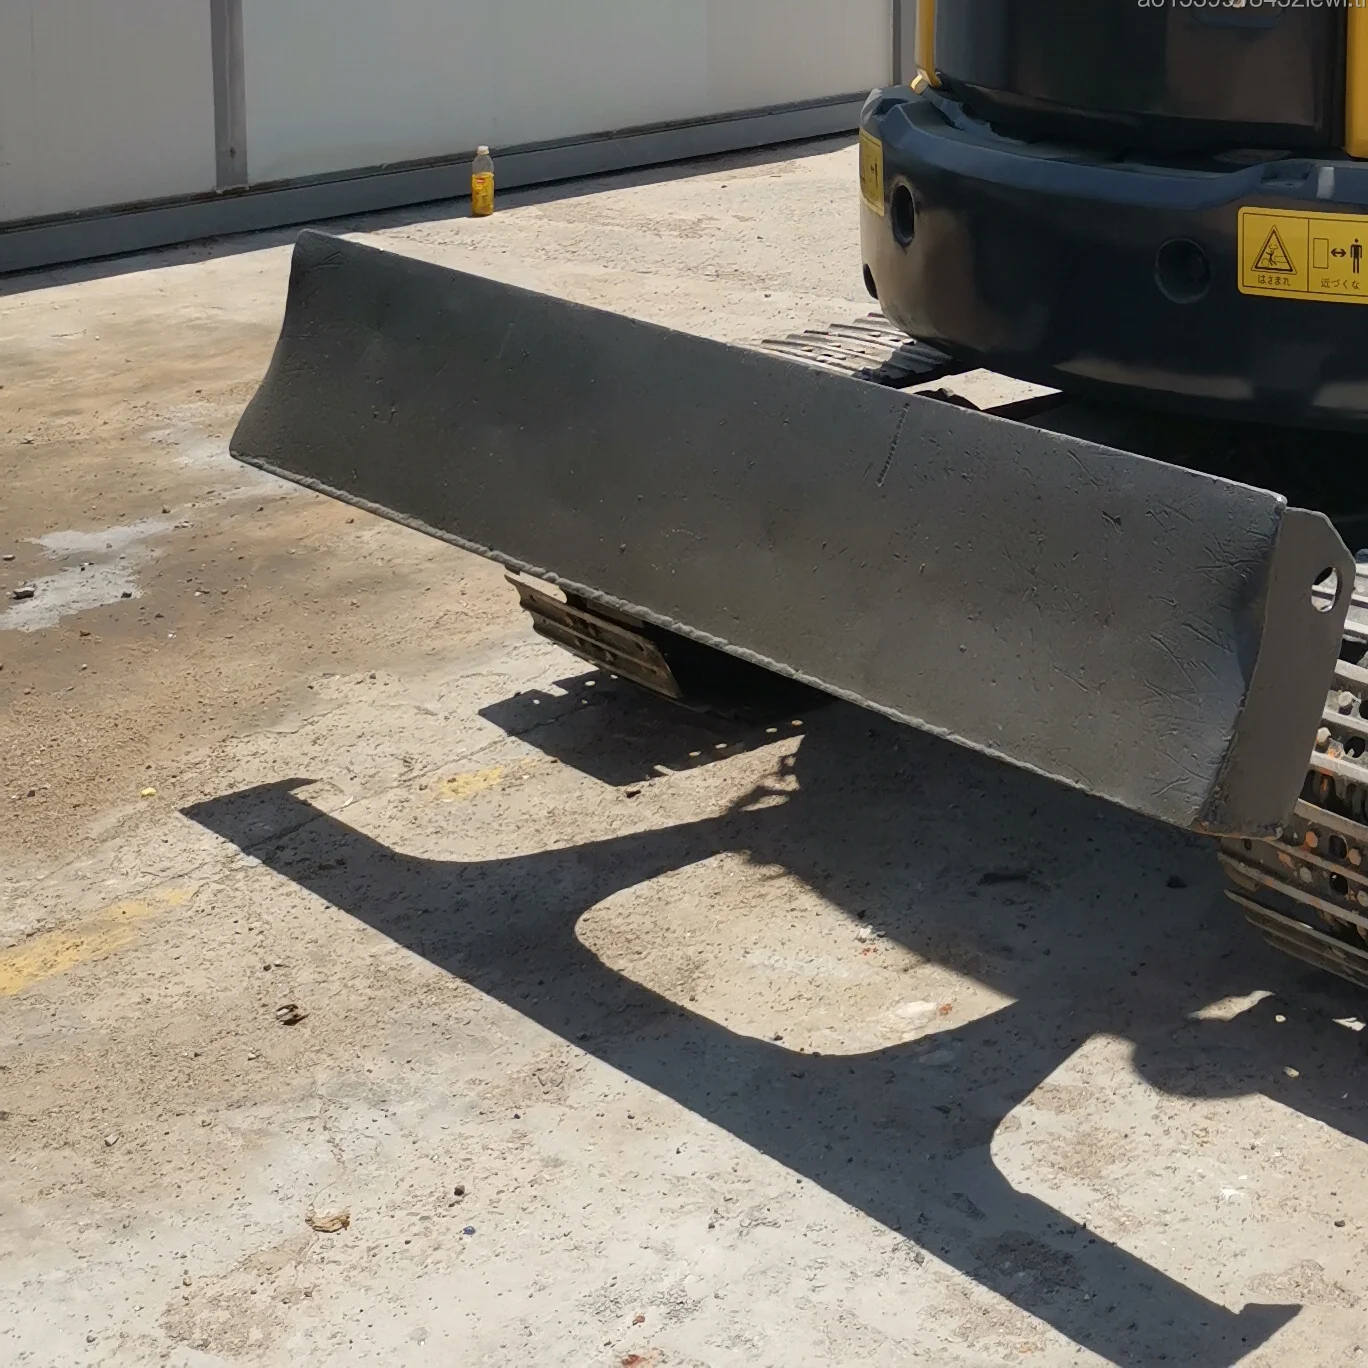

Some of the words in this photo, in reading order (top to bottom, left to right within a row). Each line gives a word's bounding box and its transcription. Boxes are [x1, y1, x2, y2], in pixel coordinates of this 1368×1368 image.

[1257, 274, 1292, 287] はさまれ
[1320, 277, 1361, 291] 近づくな
